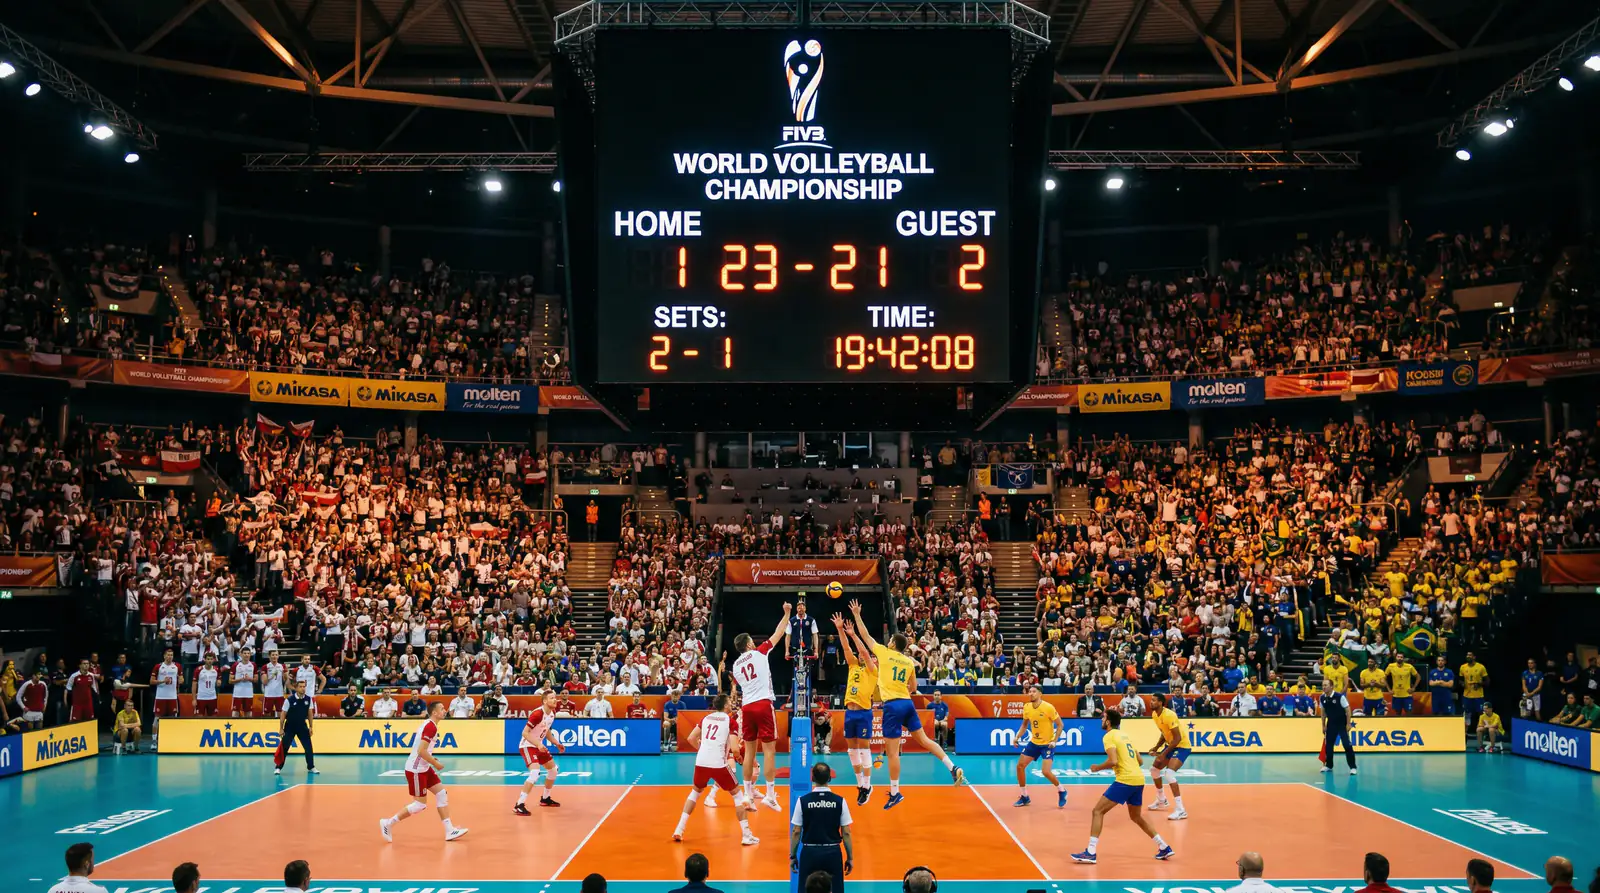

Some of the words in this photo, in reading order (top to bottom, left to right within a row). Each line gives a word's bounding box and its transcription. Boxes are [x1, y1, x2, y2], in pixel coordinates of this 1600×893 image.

[673, 153, 768, 174] WORLD
[773, 153, 934, 174] VOLLEYBALL
[704, 179, 903, 200] CHAMPIONSHIP
[614, 211, 702, 236] HOME
[896, 210, 996, 236] GUEST
[678, 246, 687, 289] 1
[720, 244, 778, 291] 23
[829, 244, 887, 291] 21
[958, 244, 985, 291] 2
[654, 306, 727, 328] SETS:
[867, 306, 935, 328] TIME:
[649, 335, 670, 371] 2
[724, 336, 732, 370] 1
[835, 335, 975, 371] 19:42:08
[464, 387, 521, 402] molten
[1188, 381, 1246, 397] molten
[741, 662, 757, 682] 12
[892, 665, 907, 683] 14
[705, 723, 719, 740] 12
[1524, 730, 1578, 759] molten
[807, 799, 837, 809] molten
